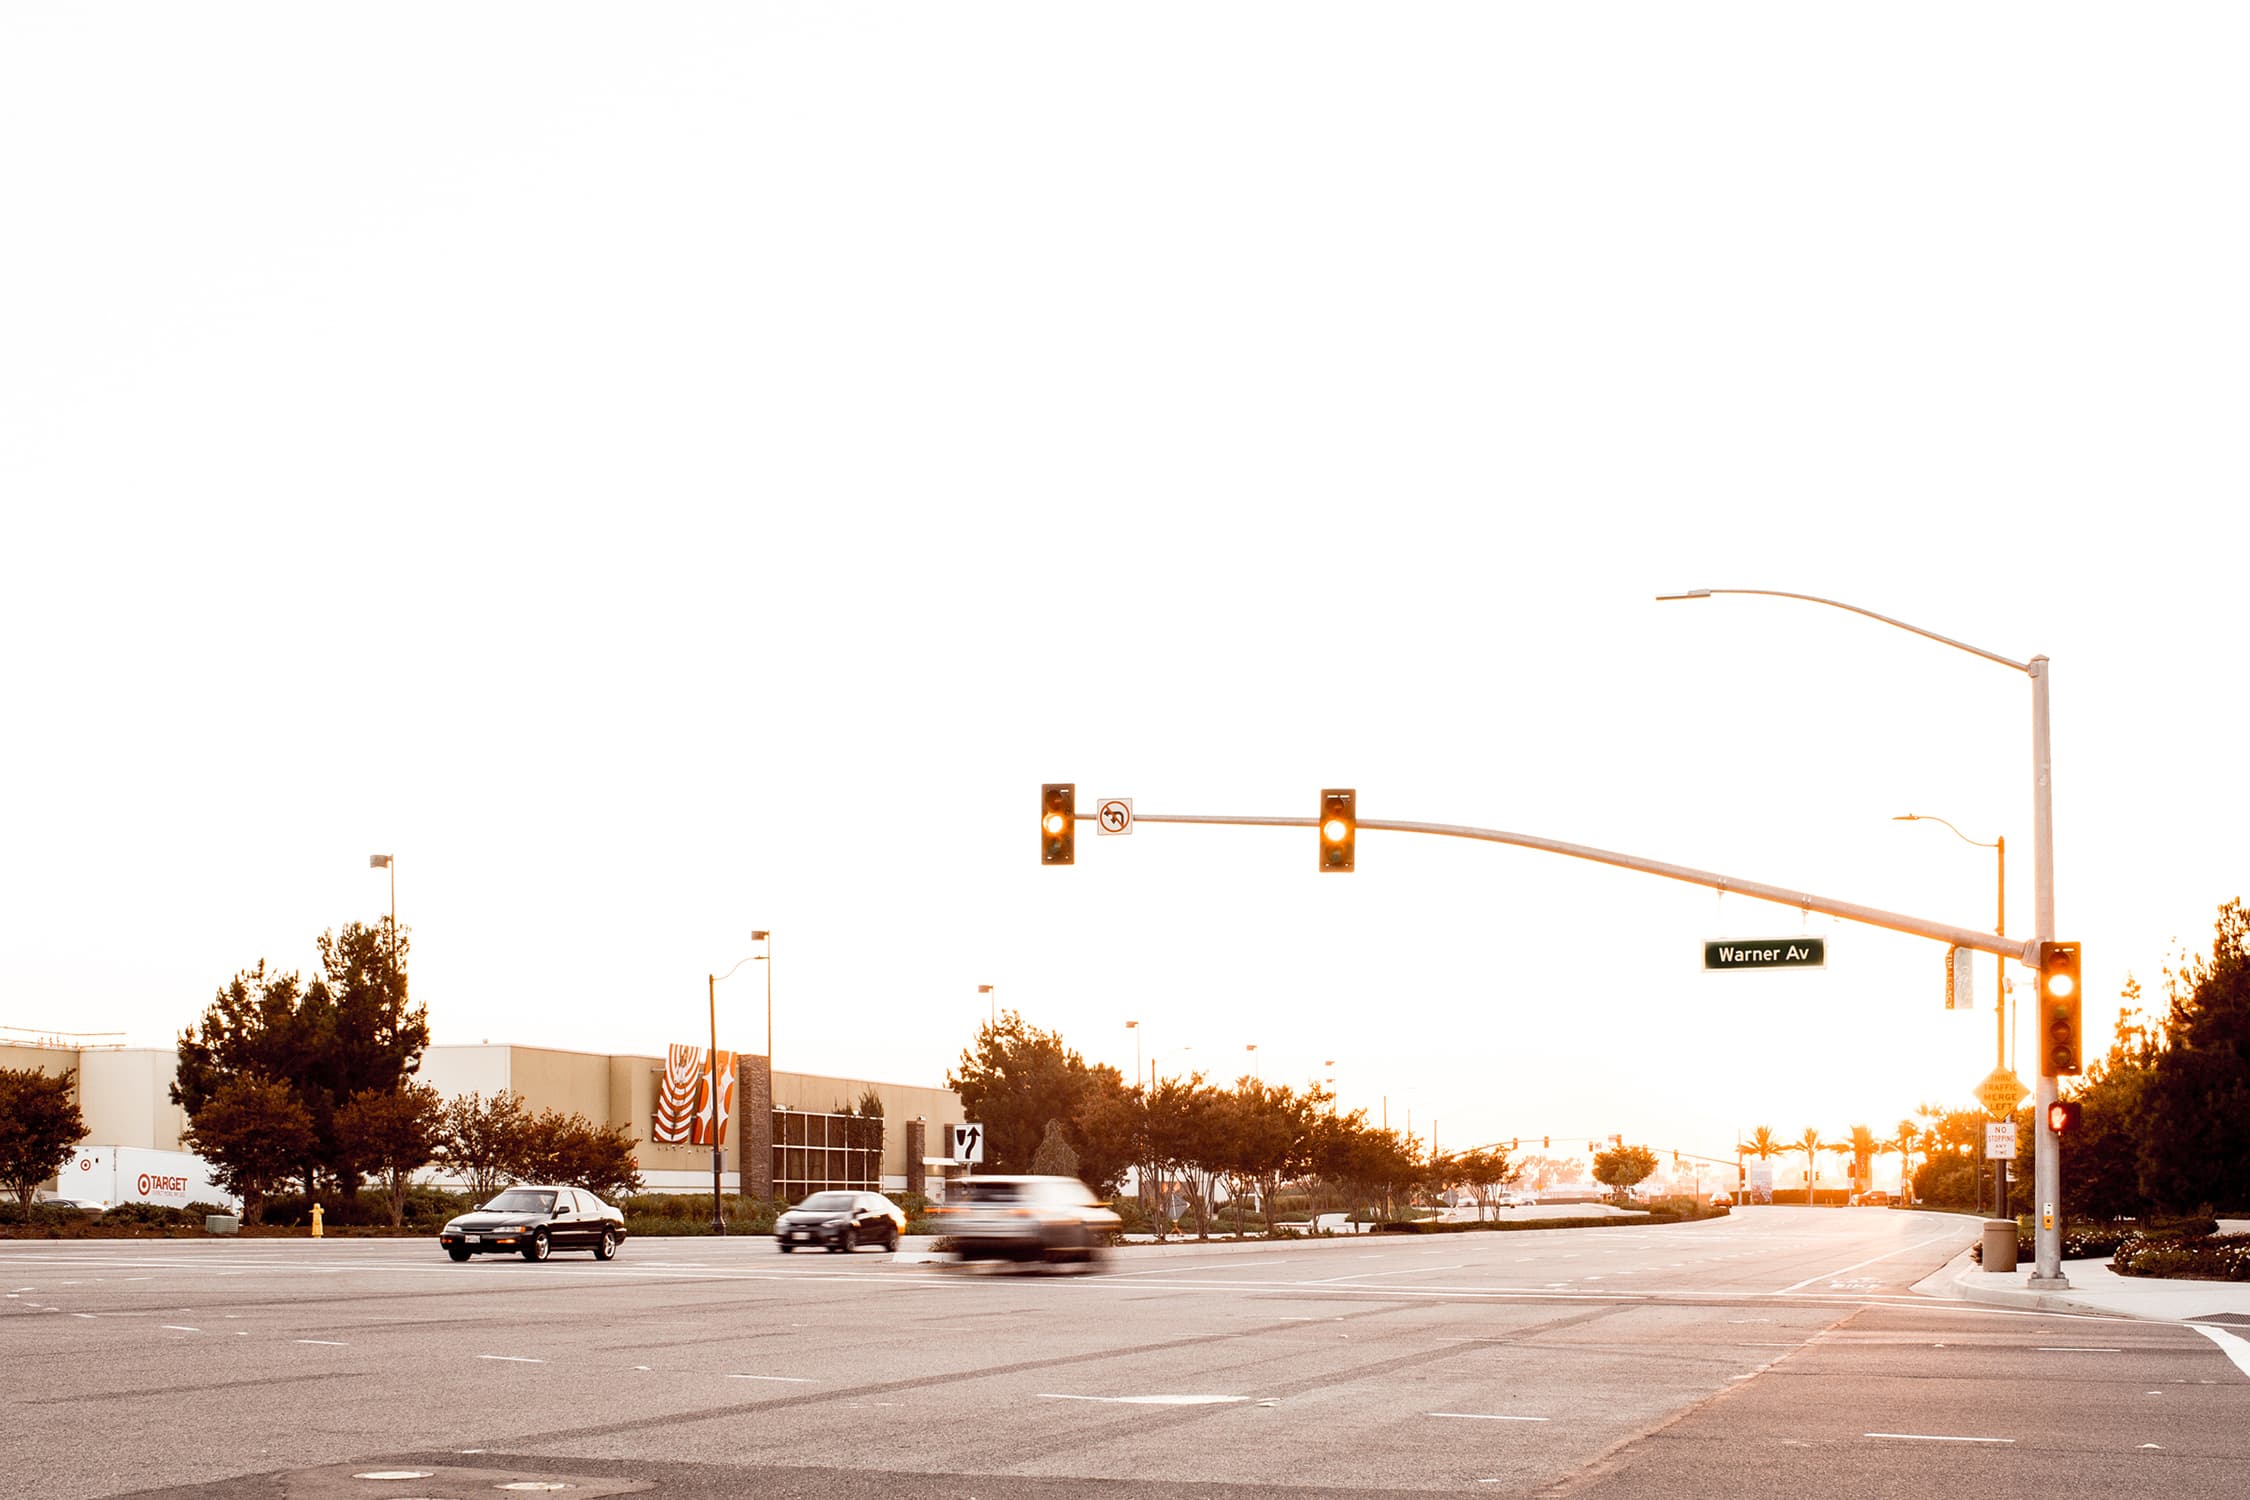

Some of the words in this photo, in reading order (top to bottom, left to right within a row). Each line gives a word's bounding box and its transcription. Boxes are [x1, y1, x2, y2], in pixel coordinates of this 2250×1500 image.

[1719, 947, 1780, 962] Warner
[1786, 945, 1809, 960] Av
[1984, 1083, 2017, 1091] TRAFFIC
[1984, 1093, 2017, 1101] MERGE
[151, 1175, 188, 1191] TARGET
